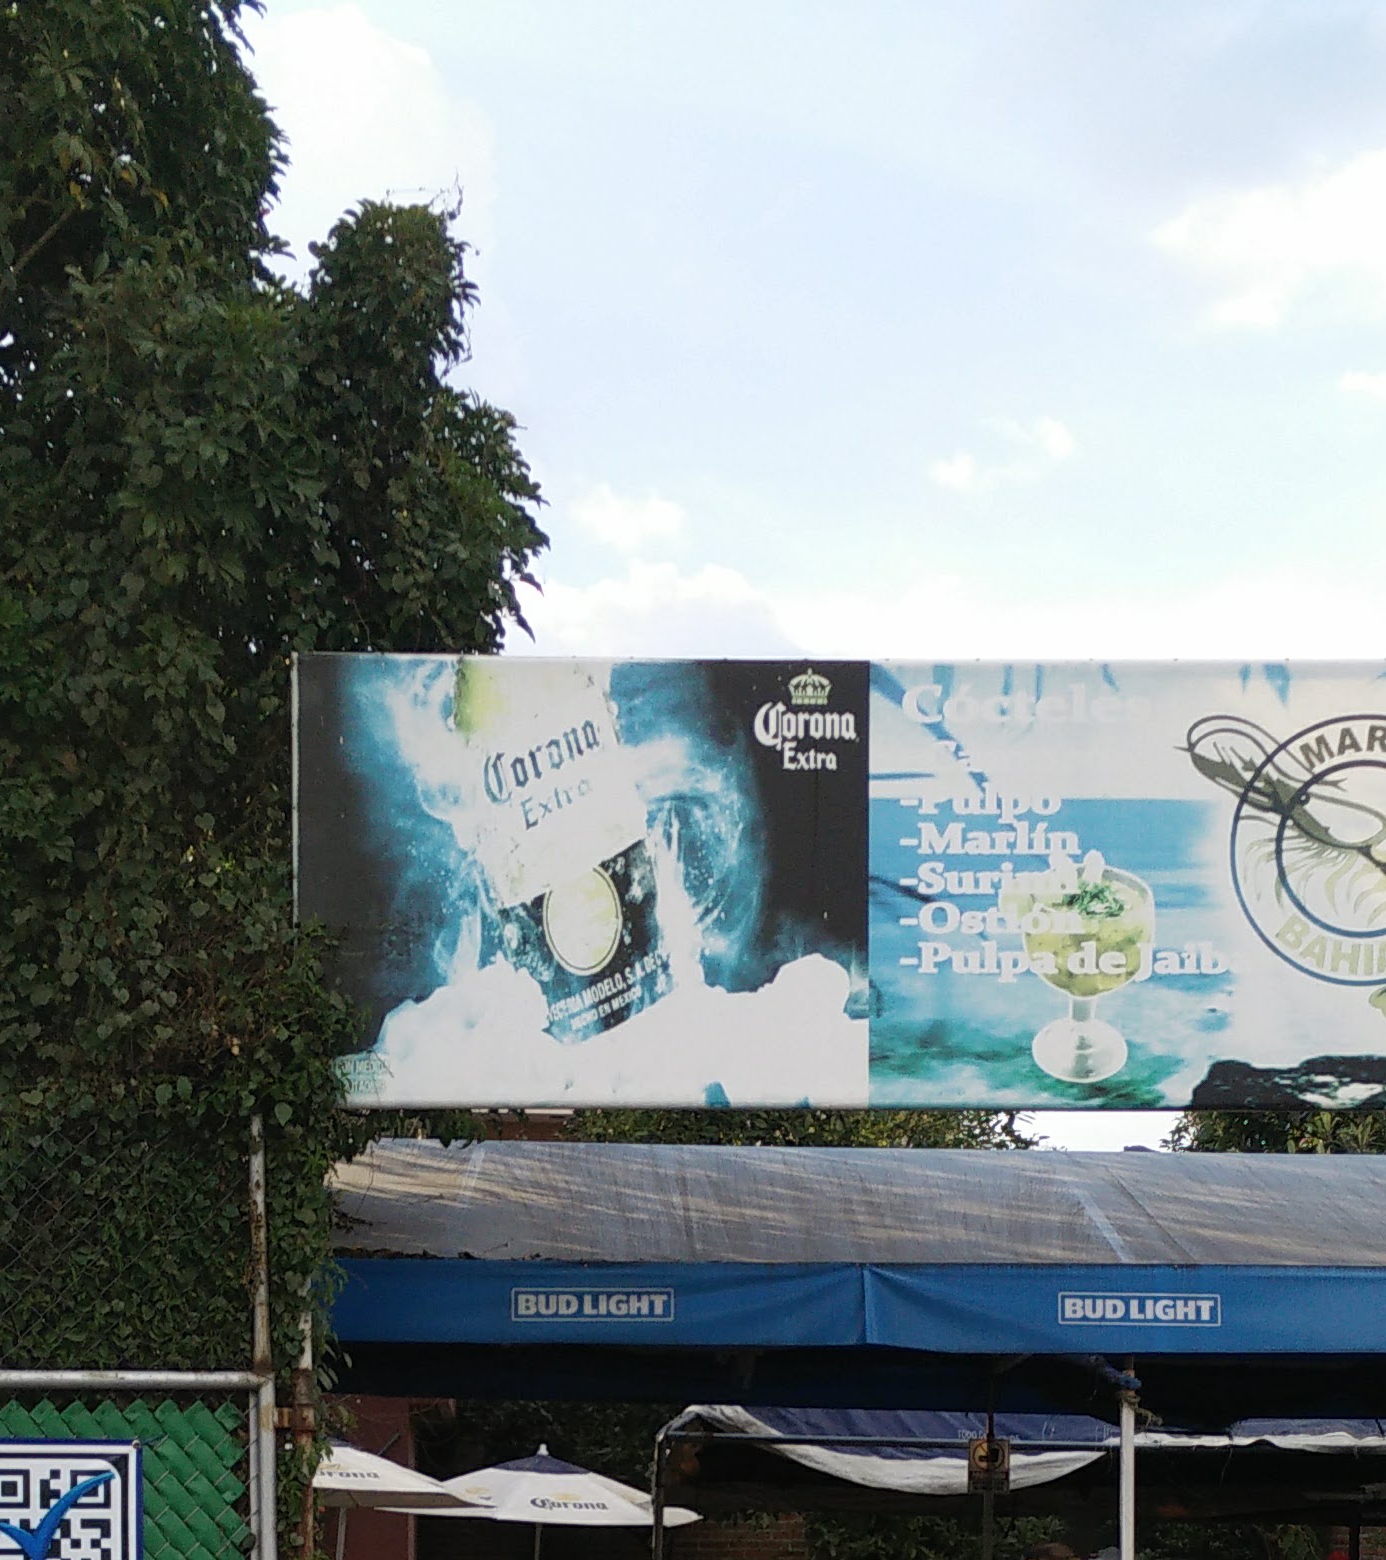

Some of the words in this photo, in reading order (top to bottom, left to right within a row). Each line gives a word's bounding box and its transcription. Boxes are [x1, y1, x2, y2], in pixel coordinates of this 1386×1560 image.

[754, 701, 859, 749] Corona
[484, 715, 602, 804] Corona
[782, 744, 838, 771] Extra
[1067, 941, 1127, 976] de
[1132, 942, 1230, 983] Jaib
[518, 1294, 579, 1316] BUD
[583, 1294, 667, 1317] LIGHT
[1064, 1297, 1125, 1321] BUD
[1129, 1297, 1215, 1322] LIGHT
[314, 1469, 380, 1480] orona
[530, 1497, 609, 1511] Corona
